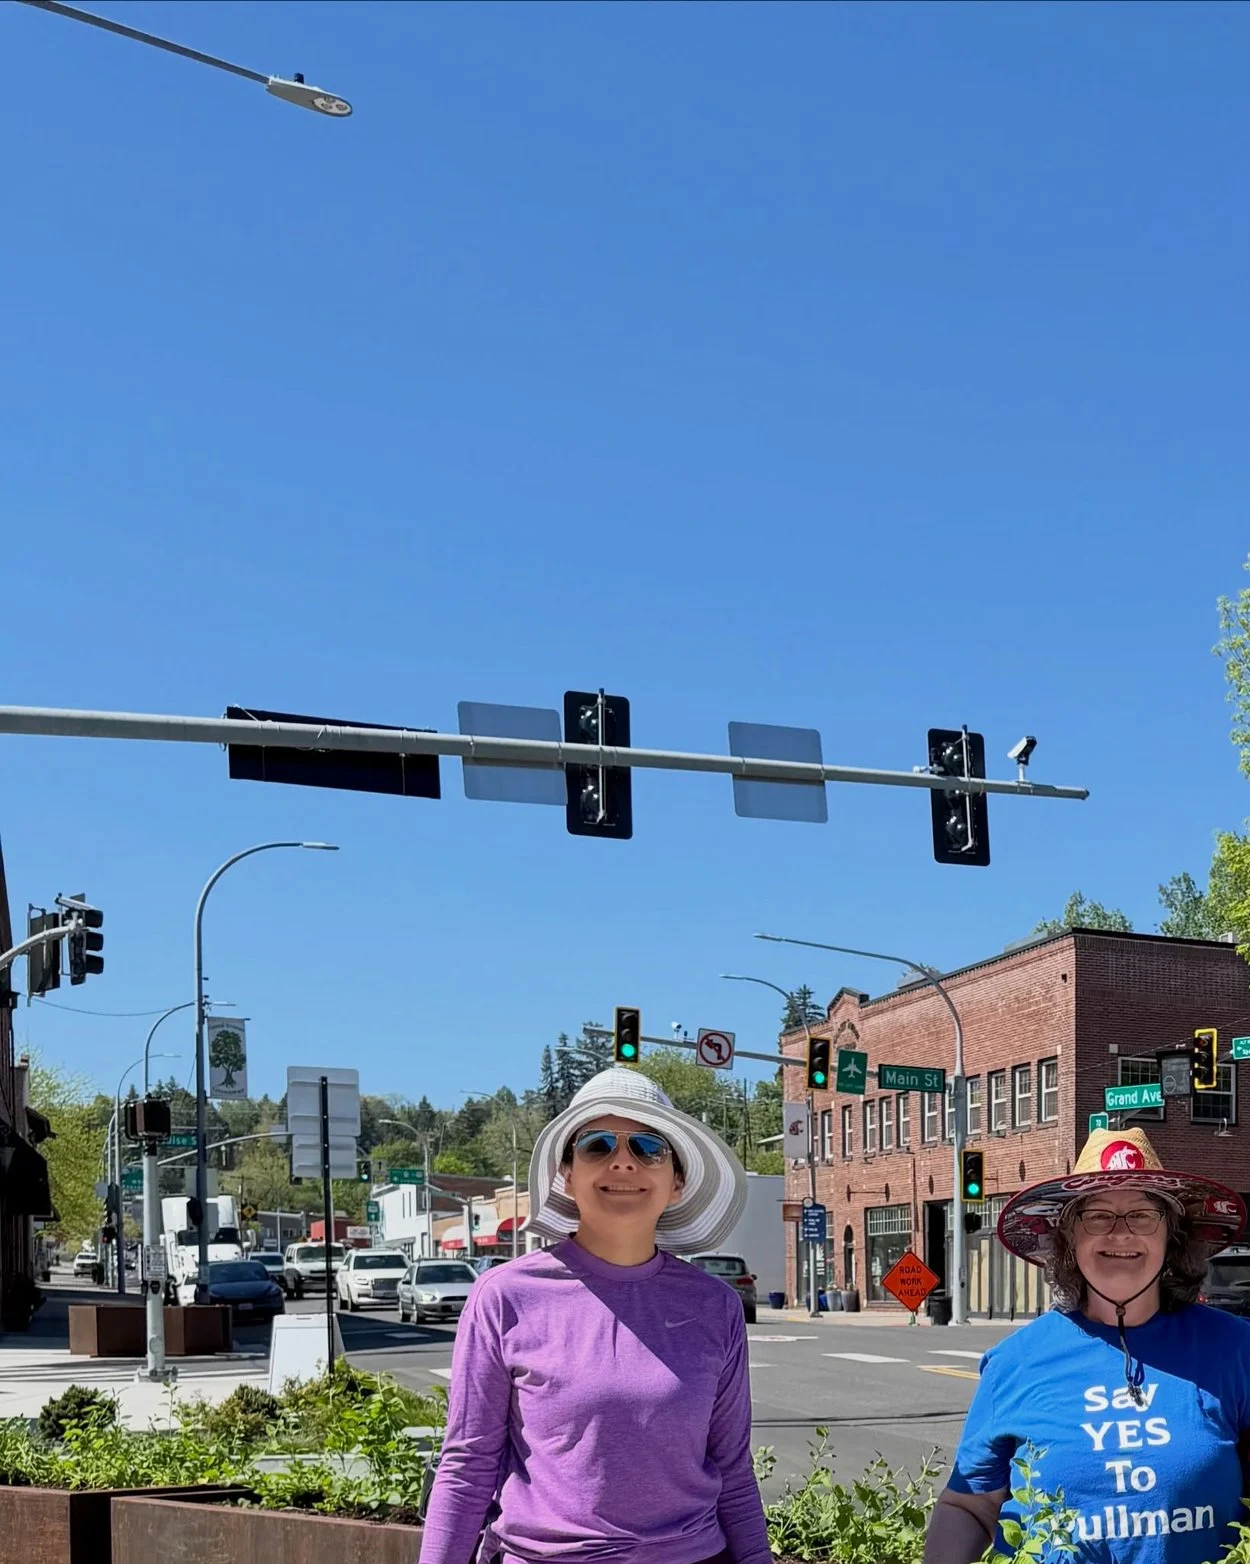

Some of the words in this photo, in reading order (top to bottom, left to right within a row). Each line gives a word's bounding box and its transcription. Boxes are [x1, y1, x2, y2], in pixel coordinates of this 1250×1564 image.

[886, 1070, 919, 1086] Main
[924, 1073, 939, 1088] St
[1107, 1090, 1138, 1106] Grand
[1142, 1089, 1162, 1103] Ave
[1062, 1173, 1181, 1191] Cougars
[899, 1265, 922, 1274] ROAD
[900, 1277, 922, 1286] WORK
[898, 1288, 926, 1297] AHEAD
[1080, 1417, 1171, 1451] YES
[1105, 1459, 1157, 1493] To
